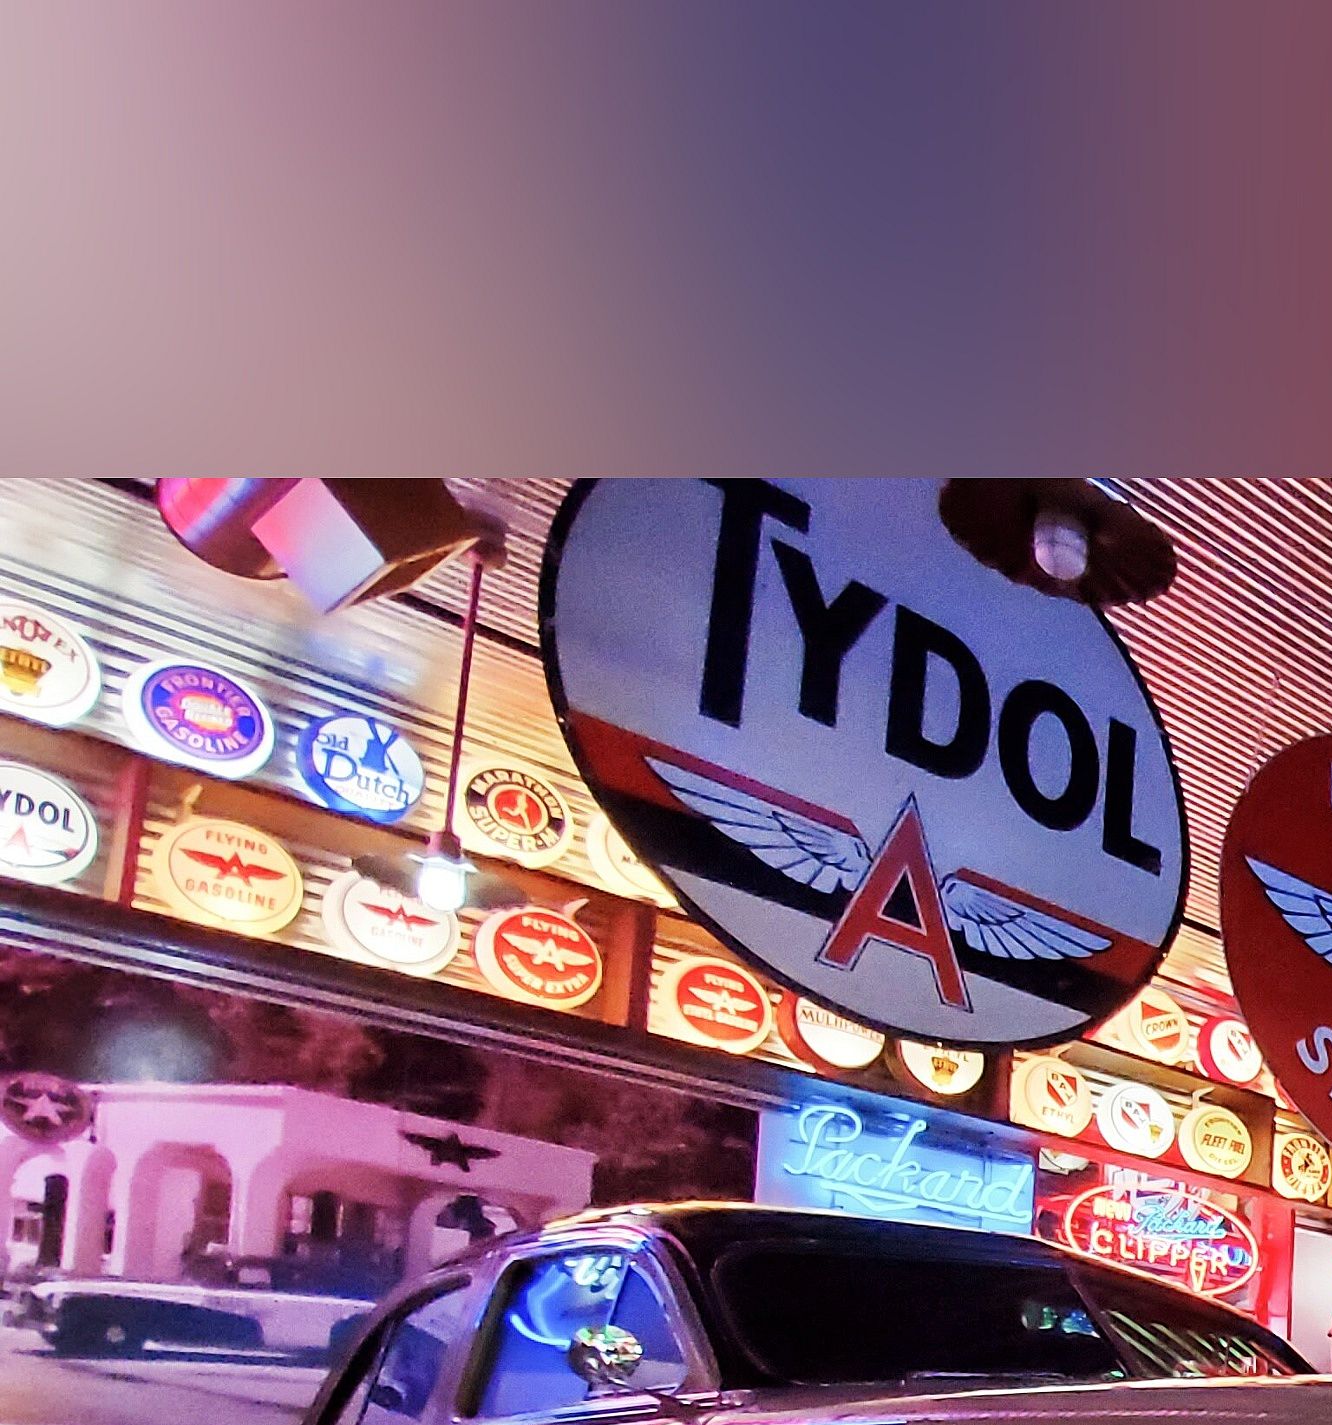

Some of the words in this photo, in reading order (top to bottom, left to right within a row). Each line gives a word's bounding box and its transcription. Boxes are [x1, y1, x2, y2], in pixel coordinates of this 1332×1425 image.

[700, 478, 1161, 876] TYDOL
[156, 706, 248, 753] GASOLINE
[322, 747, 410, 806] Dutch
[471, 769, 564, 820] MARATHON
[0, 789, 75, 833] YDOL
[206, 830, 268, 855] FLYING
[185, 879, 276, 910] GASOLINE
[521, 916, 579, 942] FLYING
[1146, 1017, 1178, 1036] CROWN
[1042, 1107, 1075, 1124] ETHYL
[783, 1105, 1034, 1217] Packard
[1091, 1228, 1229, 1276] CLIPPER
